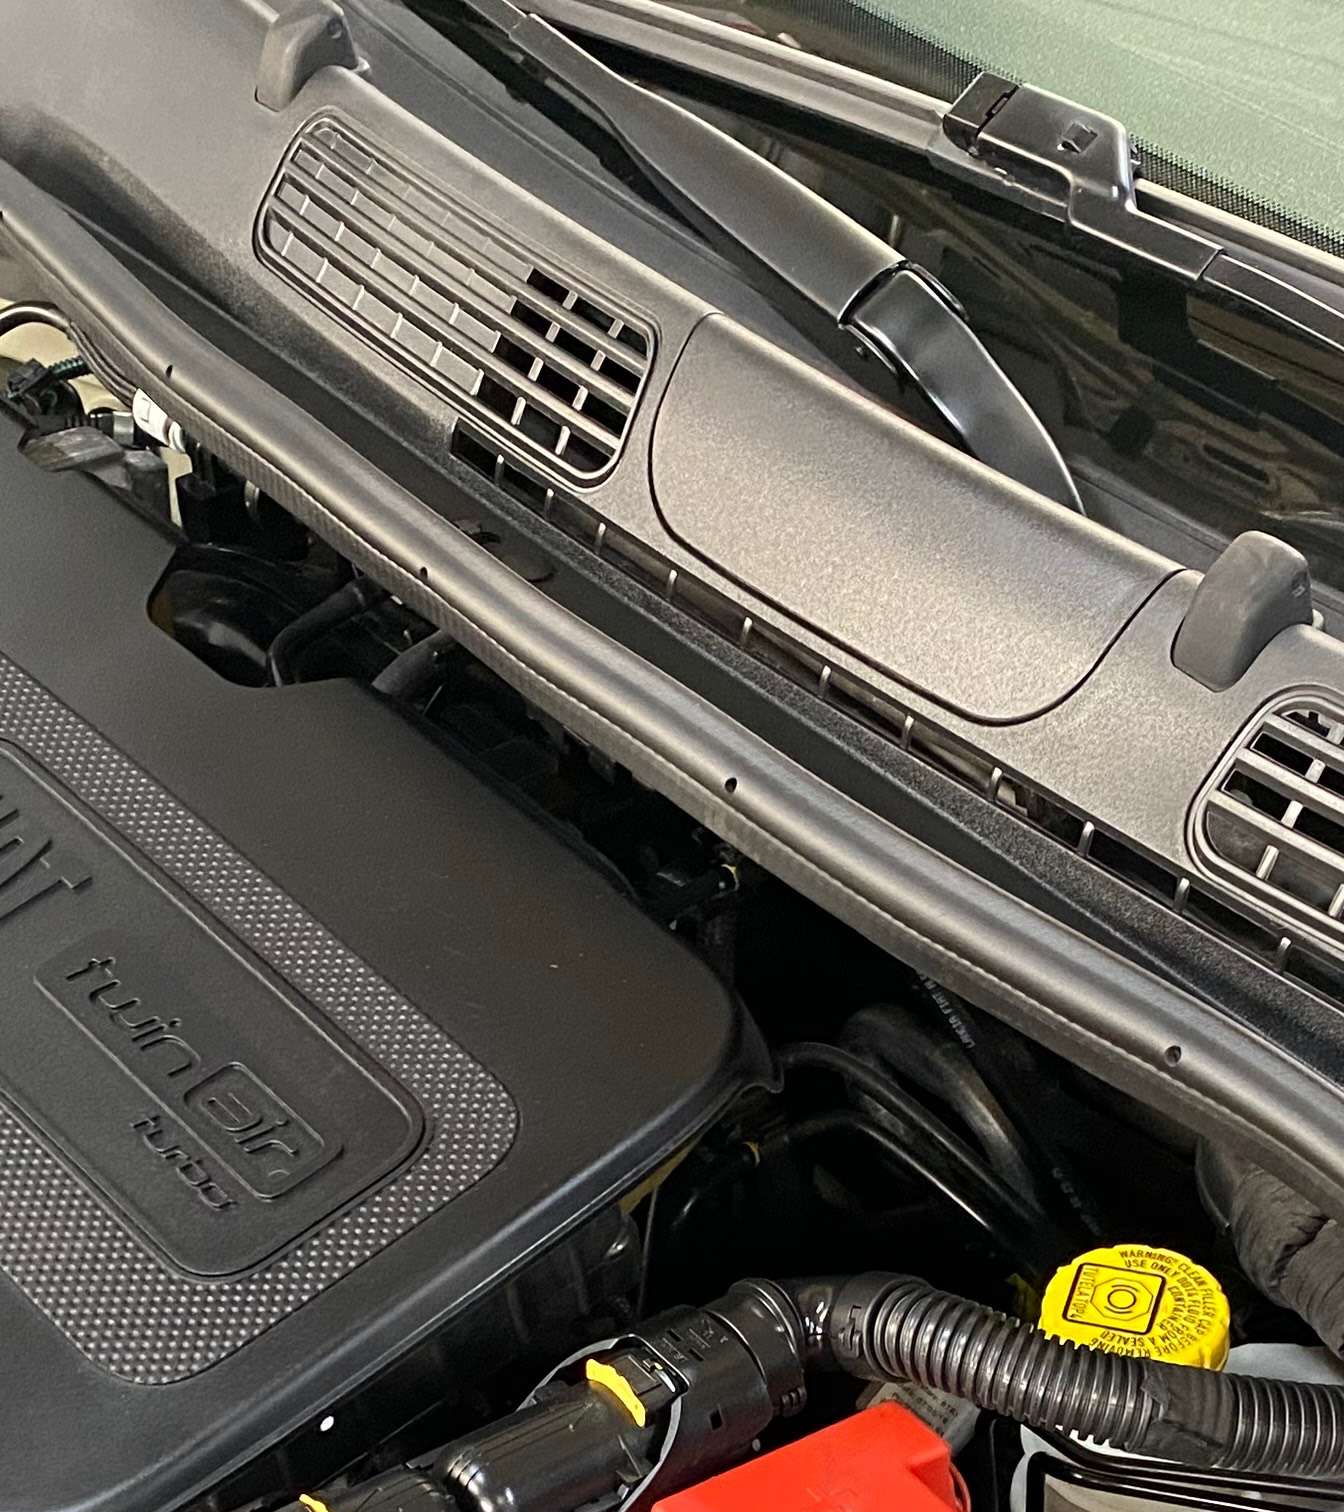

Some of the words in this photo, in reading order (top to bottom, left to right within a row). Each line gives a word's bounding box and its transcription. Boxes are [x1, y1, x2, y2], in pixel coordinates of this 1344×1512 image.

[133, 1109, 242, 1214] turbo
[1074, 1267, 1099, 1297] TUTELA
[1124, 1259, 1149, 1268] USE
[1150, 1261, 1178, 1278] ONLY
[1187, 1298, 1200, 1324] FLUID
[1069, 1299, 1089, 1314] TOP
[1159, 1285, 1186, 1331] CONTAINER
[1202, 1285, 1216, 1318] FILLER
[1195, 1318, 1208, 1335] CAP
